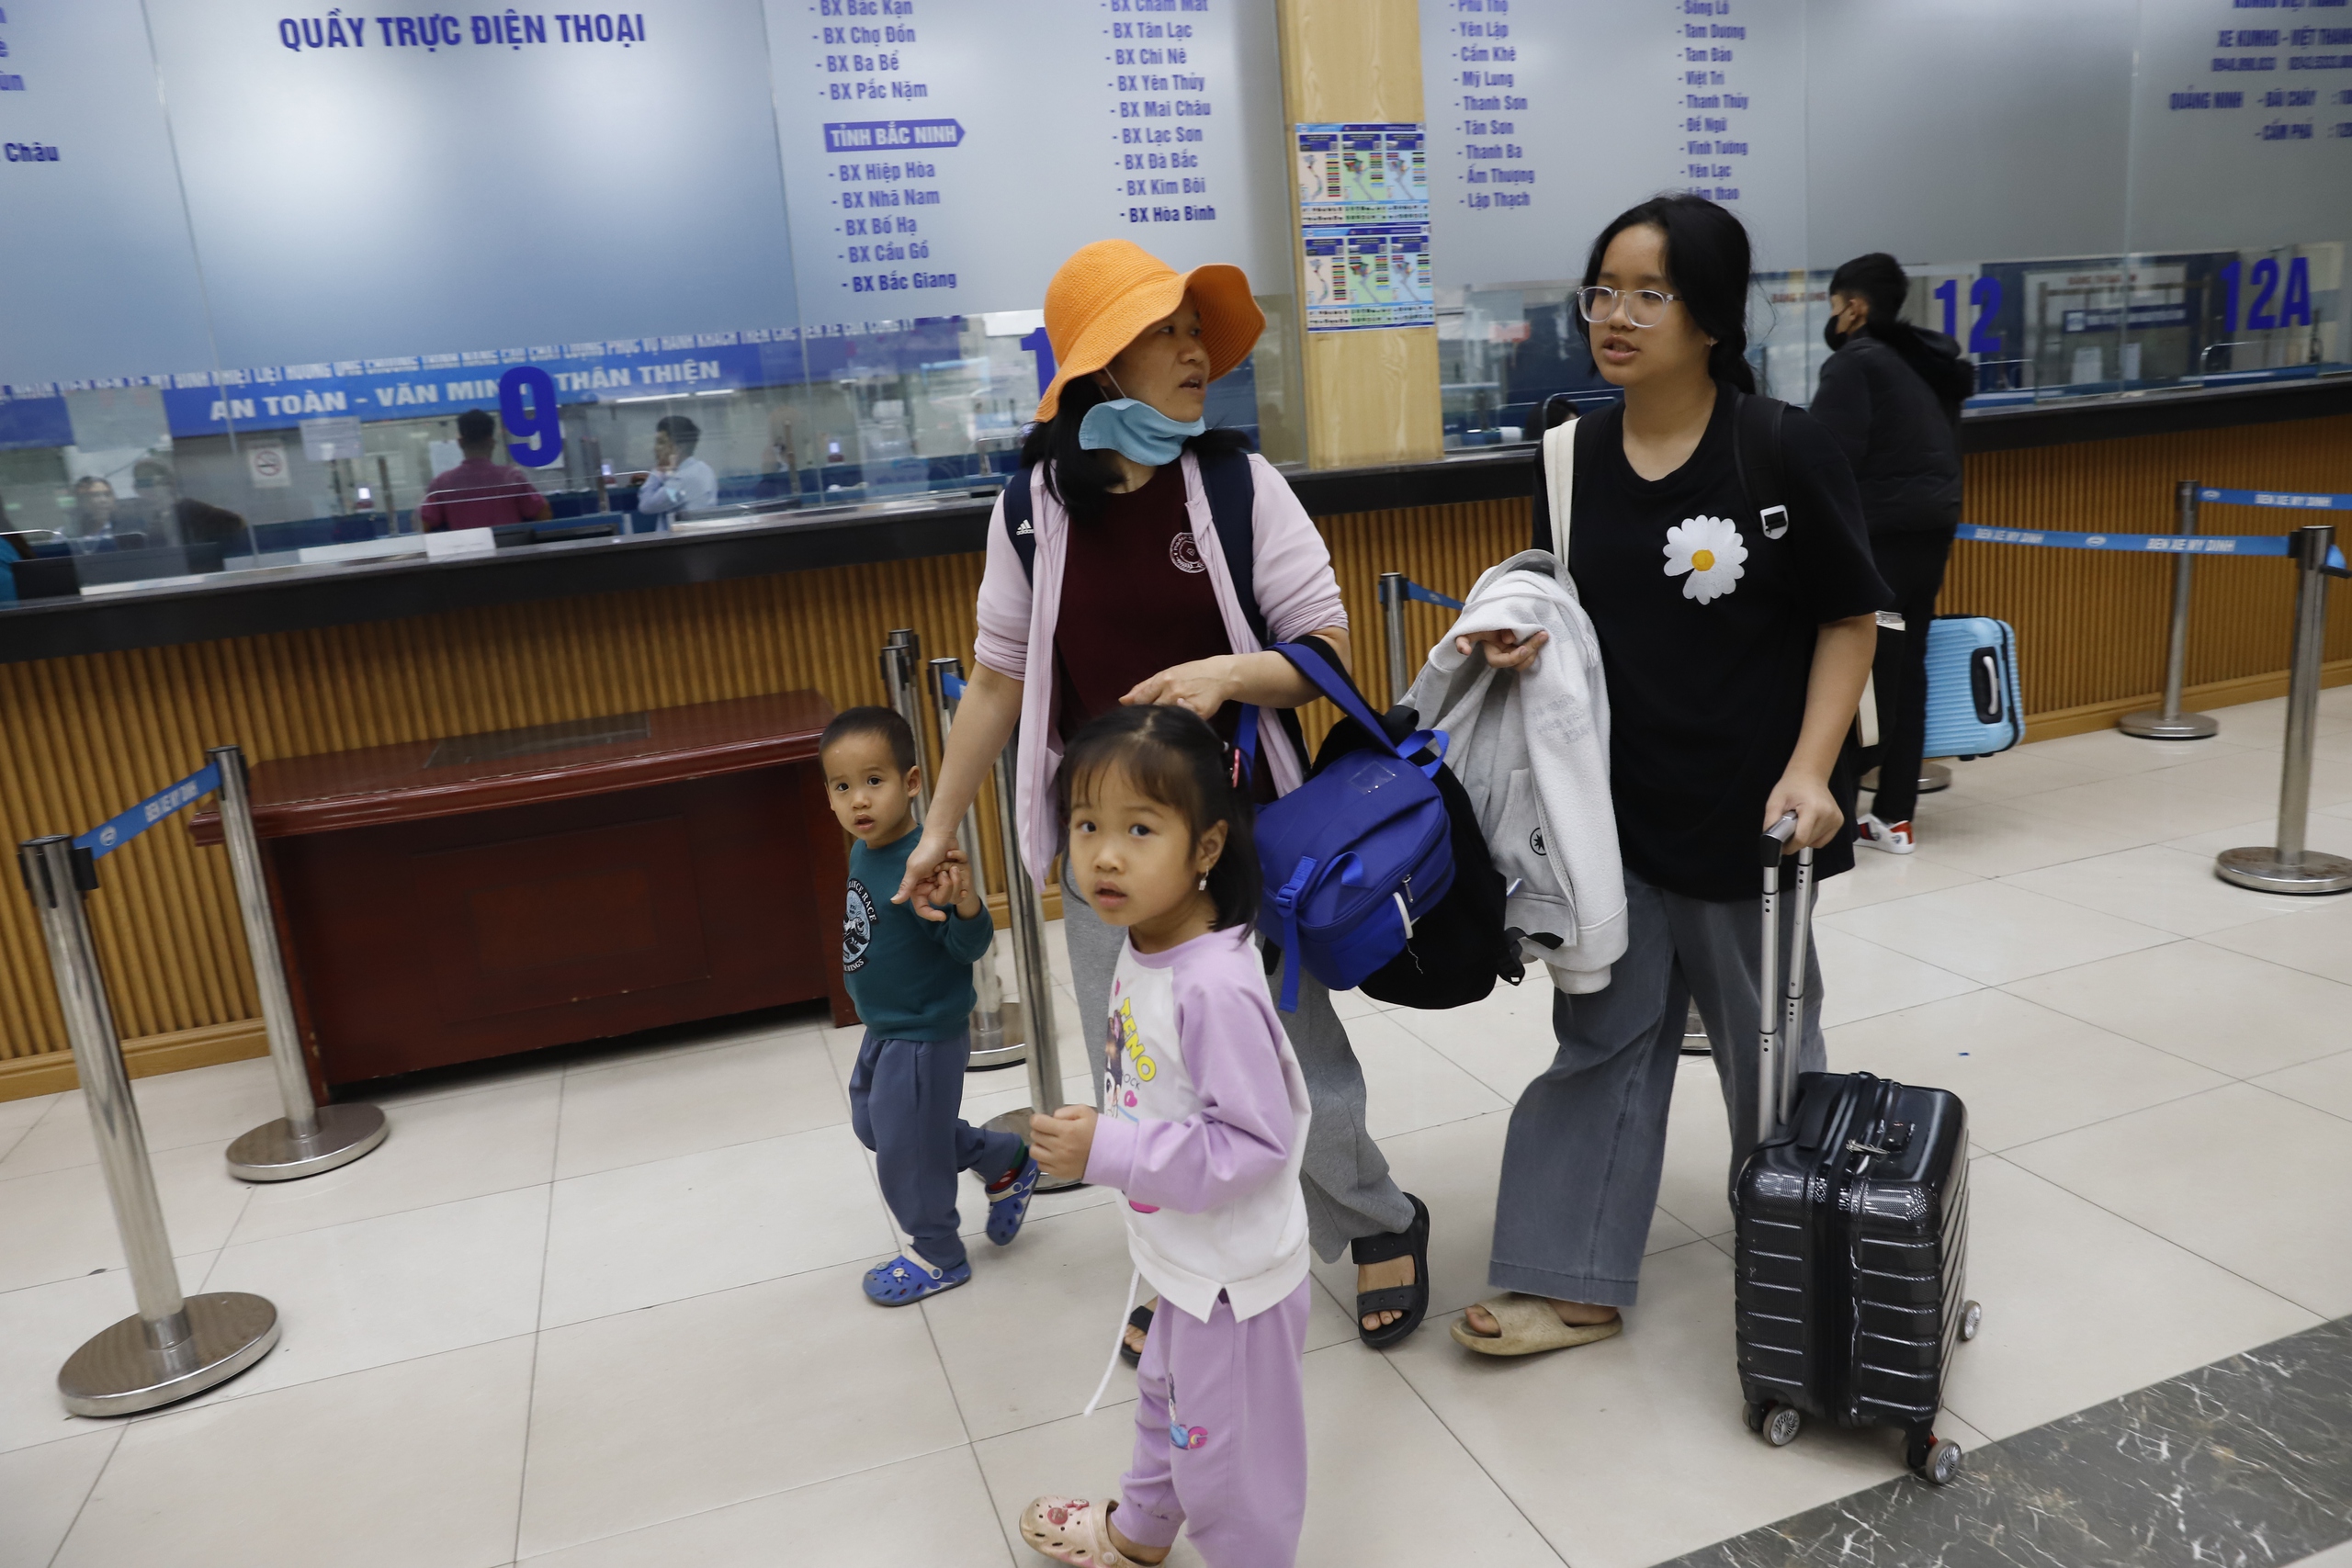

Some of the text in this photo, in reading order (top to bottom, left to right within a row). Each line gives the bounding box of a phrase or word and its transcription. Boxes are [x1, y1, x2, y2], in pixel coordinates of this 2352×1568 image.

[820, 0, 842, 16] BX
[377, 13, 462, 52] TRỰC
[470, 8, 547, 51] ĐIỆN
[555, 13, 646, 49] THOẠI
[823, 27, 846, 44] BX
[851, 27, 881, 47] Chợ
[1113, 21, 1193, 41] BX Tân Lạc
[827, 55, 849, 72] BX
[854, 55, 874, 72] Ba
[1115, 48, 1187, 65] BX Chi Nê
[830, 83, 852, 100] BX
[891, 81, 928, 101] Nặm
[1117, 75, 1138, 92] BX
[1141, 74, 1169, 91] Yên
[1120, 99, 1211, 118] BX Mai Châu
[830, 121, 957, 147] TỈNH BẮC NINH
[1123, 126, 1203, 147] BX Lạc Sơn
[5, 141, 60, 163] Châu
[1125, 153, 1145, 170] BX
[1170, 149, 1198, 168] Bắc
[840, 162, 935, 183] BX Hiệp Hòa
[1126, 177, 1206, 196] BX Kim Bôi
[842, 192, 865, 209] BX
[904, 189, 940, 206] Nam
[1129, 205, 1216, 223] BX Hòa Bình
[845, 215, 917, 236] BX Bố Hạ
[848, 246, 871, 263] BX
[853, 270, 957, 293] BX Bắc Giang
[2221, 256, 2312, 333] 12A
[1933, 277, 2003, 354] 12
[1020, 327, 1057, 400] 1
[209, 400, 255, 421] AN
[261, 390, 346, 415] TOÀN
[376, 382, 438, 408] VĂN
[447, 375, 501, 400] MIN
[556, 368, 631, 391] THÂN
[639, 359, 720, 385] THIỆN
[499, 366, 563, 468] 9
[861, 892, 877, 922] RACE
[1119, 997, 1157, 1082] TENO
[1121, 1072, 1141, 1090] OCK
